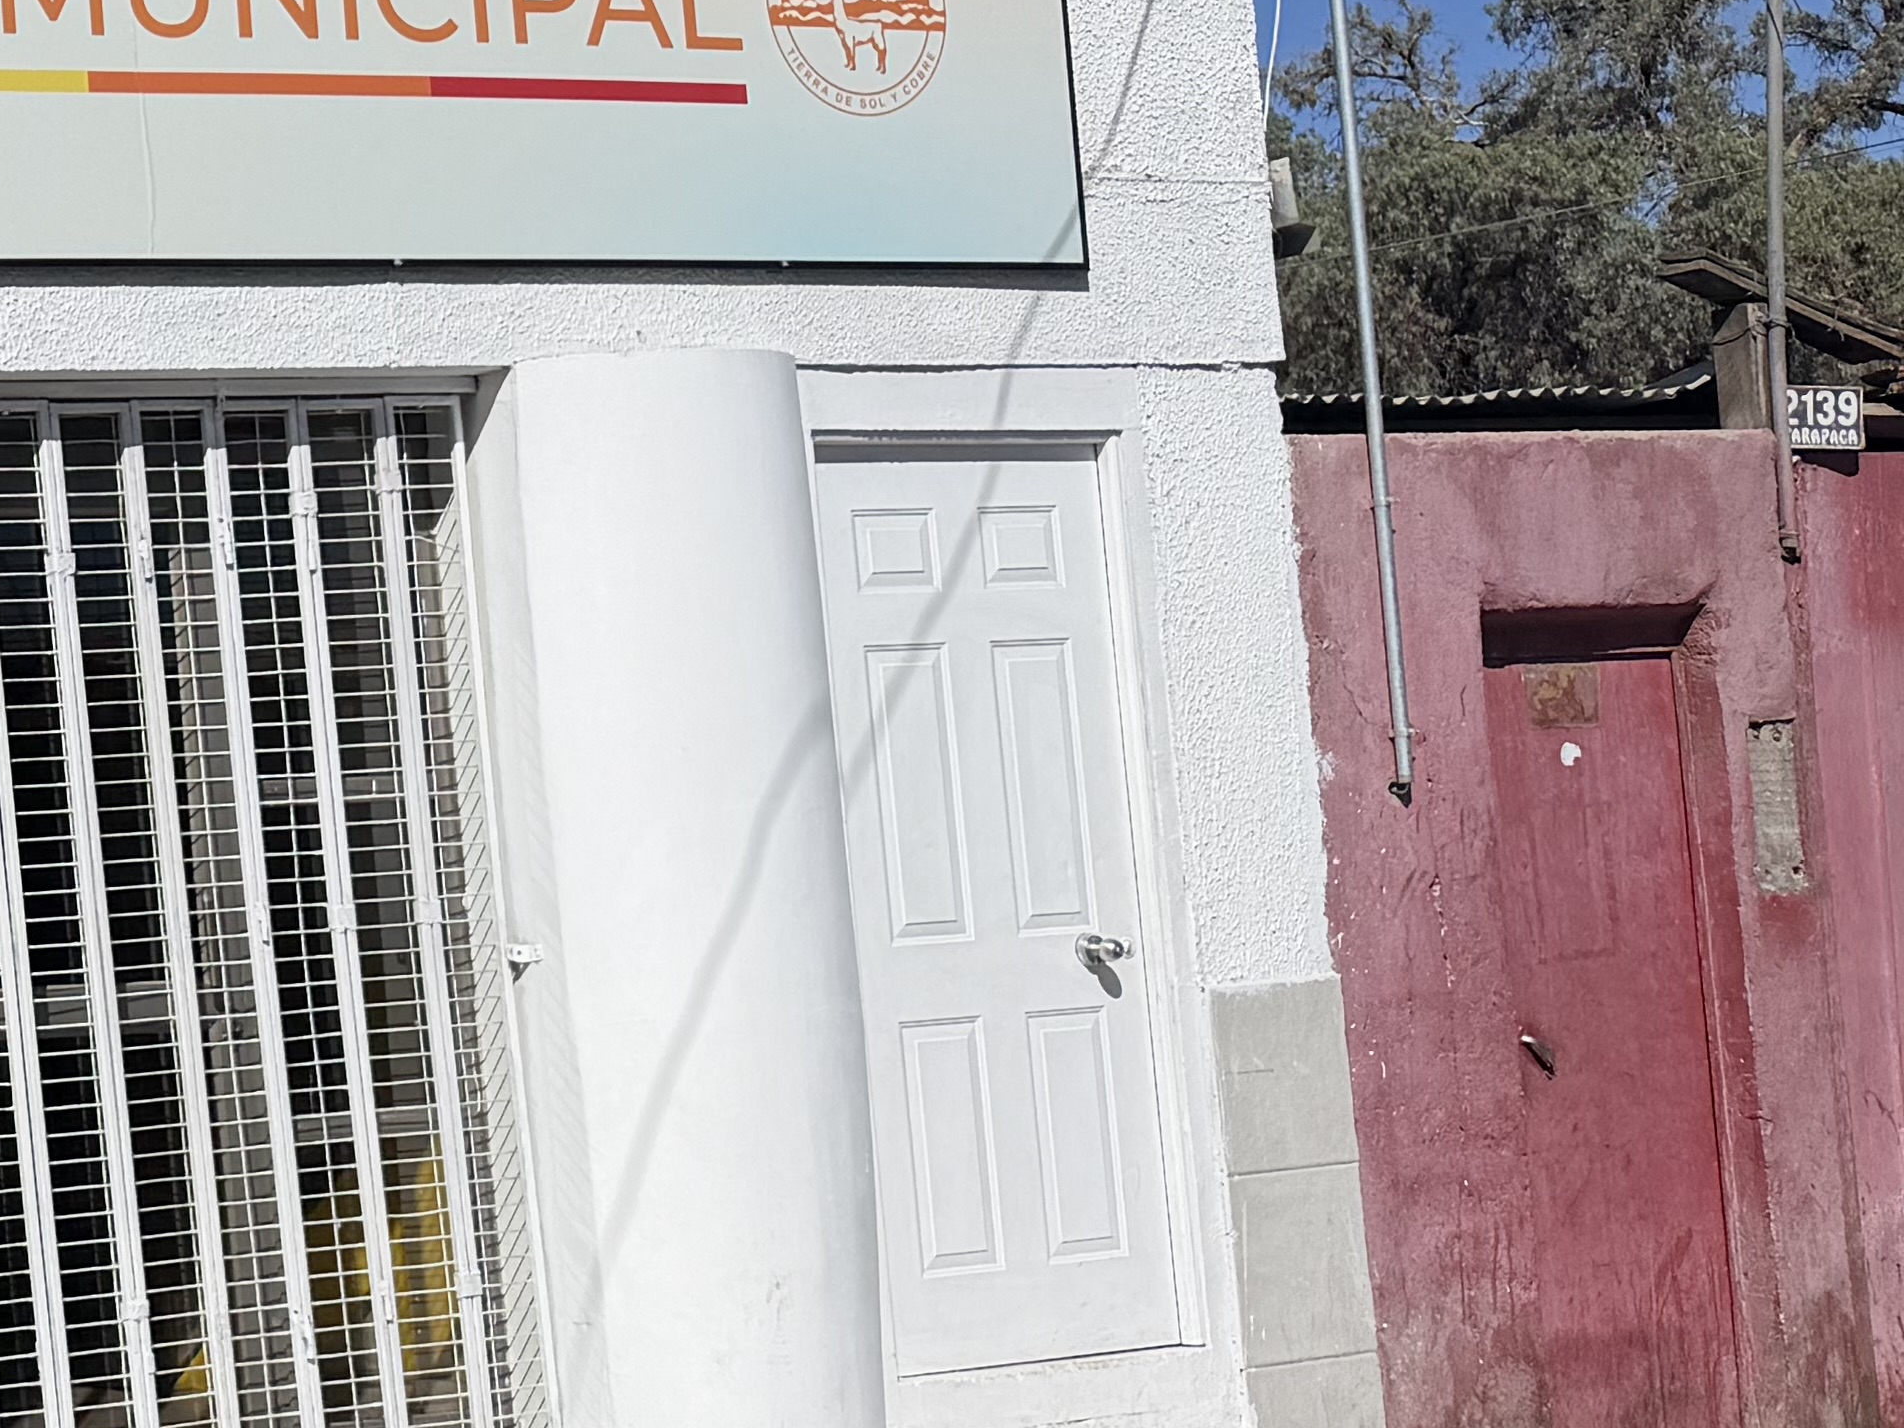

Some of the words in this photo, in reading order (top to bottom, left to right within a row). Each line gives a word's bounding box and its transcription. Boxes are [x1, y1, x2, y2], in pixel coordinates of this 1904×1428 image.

[787, 47, 829, 97] TIERRA
[835, 92, 852, 107] DE
[859, 97, 886, 109] SOL
[890, 92, 898, 103] Y
[1789, 427, 1859, 446] ARAPACA
